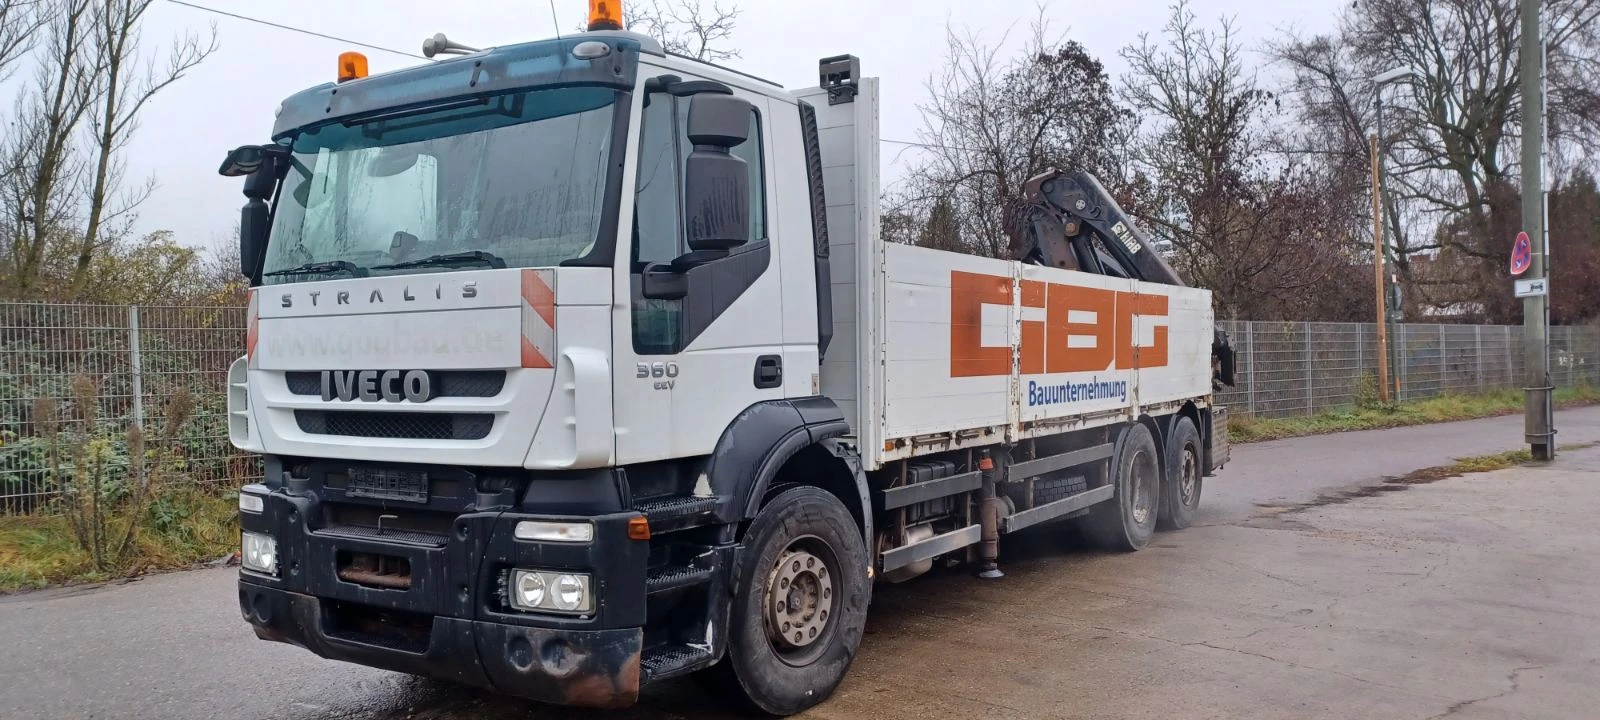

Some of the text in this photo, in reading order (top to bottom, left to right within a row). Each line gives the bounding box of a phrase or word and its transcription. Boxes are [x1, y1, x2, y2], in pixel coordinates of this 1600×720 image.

[1119, 230, 1142, 254] HIAB
[281, 280, 478, 308] STRALIS
[950, 269, 1169, 378] GBG
[636, 361, 680, 379] 360
[320, 369, 431, 403] IVECO
[1028, 375, 1127, 406] Bauunternehmung
